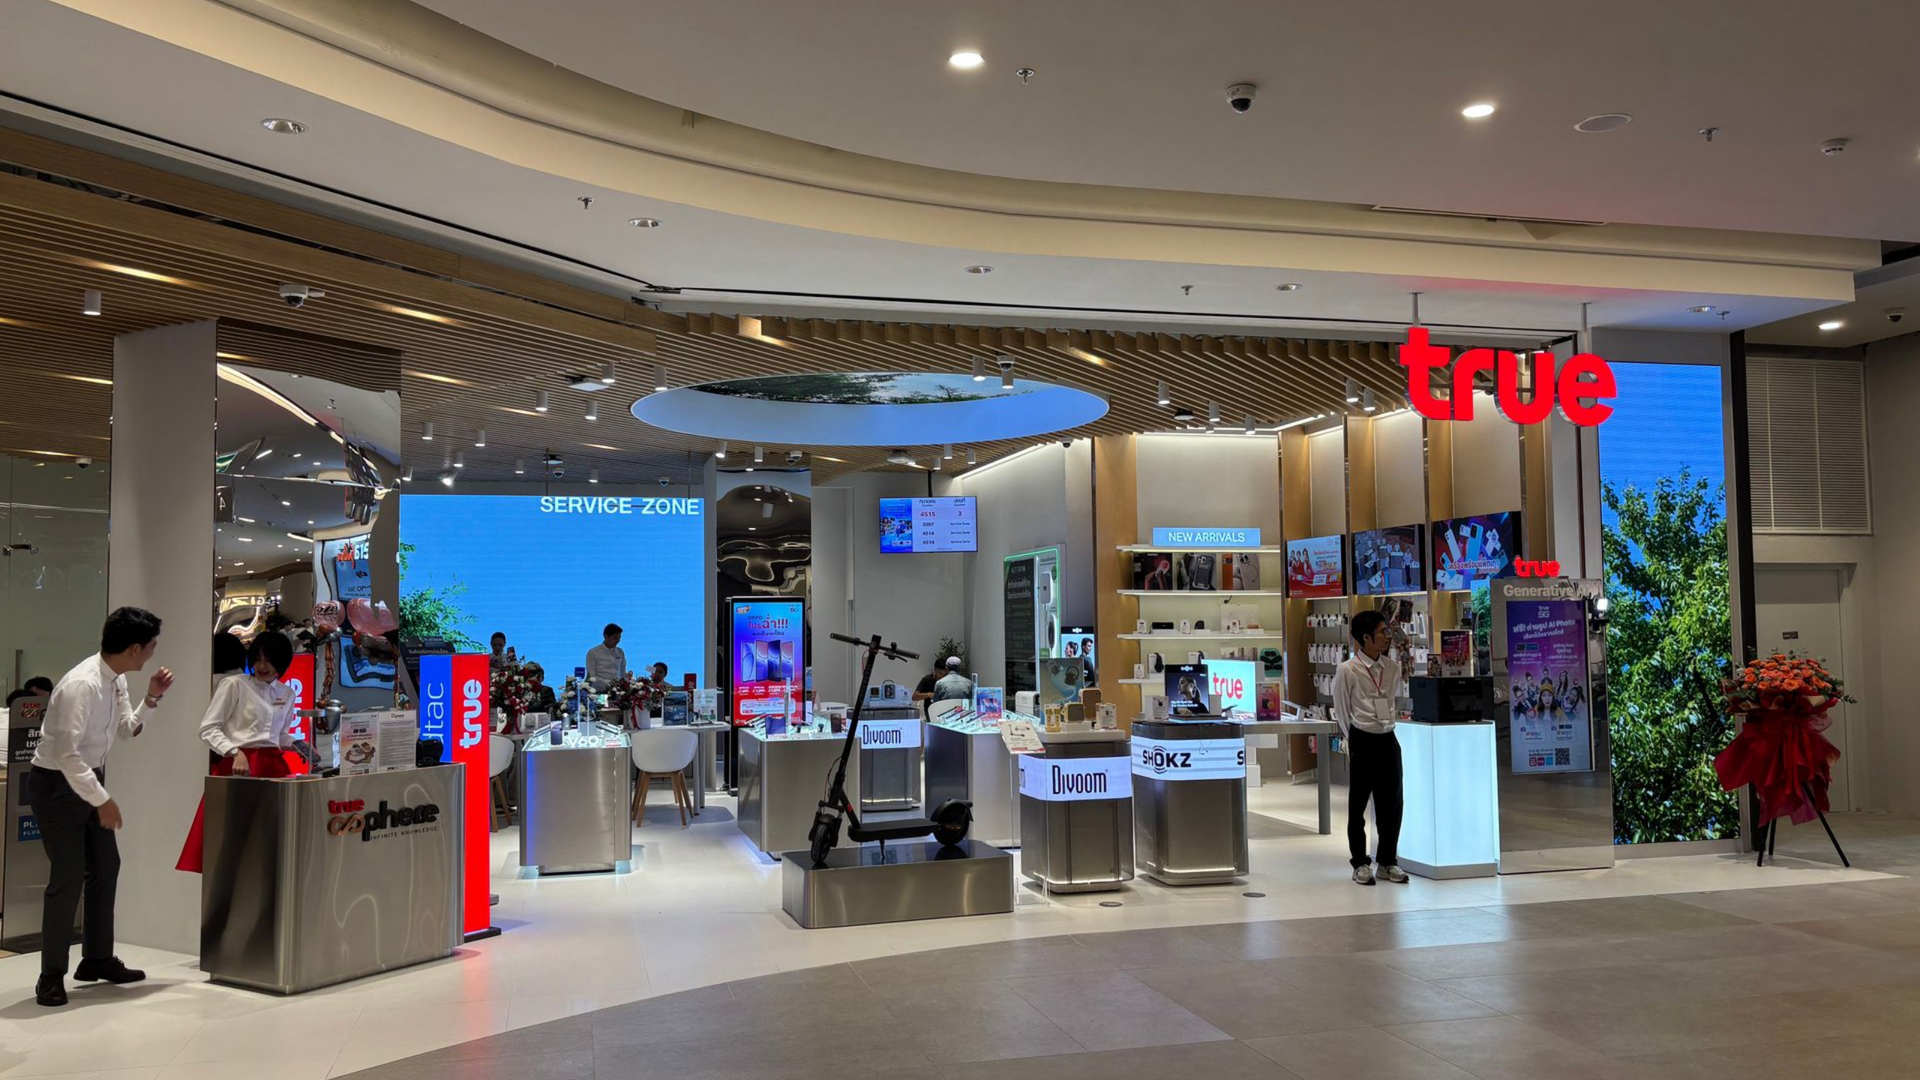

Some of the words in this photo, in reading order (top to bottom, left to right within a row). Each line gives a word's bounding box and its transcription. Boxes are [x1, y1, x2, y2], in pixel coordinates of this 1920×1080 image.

[1399, 327, 1617, 427] true
[540, 496, 632, 514] SERVICE
[641, 498, 699, 515] ZONE
[1168, 532, 1193, 542] NEW
[1195, 532, 1245, 542] ARRIVALS
[1514, 555, 1560, 578] true
[1503, 584, 1574, 597] Generative
[1213, 672, 1243, 700] true
[460, 679, 482, 748] true
[1142, 747, 1191, 773] SHOKZ
[328, 800, 364, 814] true
[401, 826, 438, 836] KNOWLEDGE
